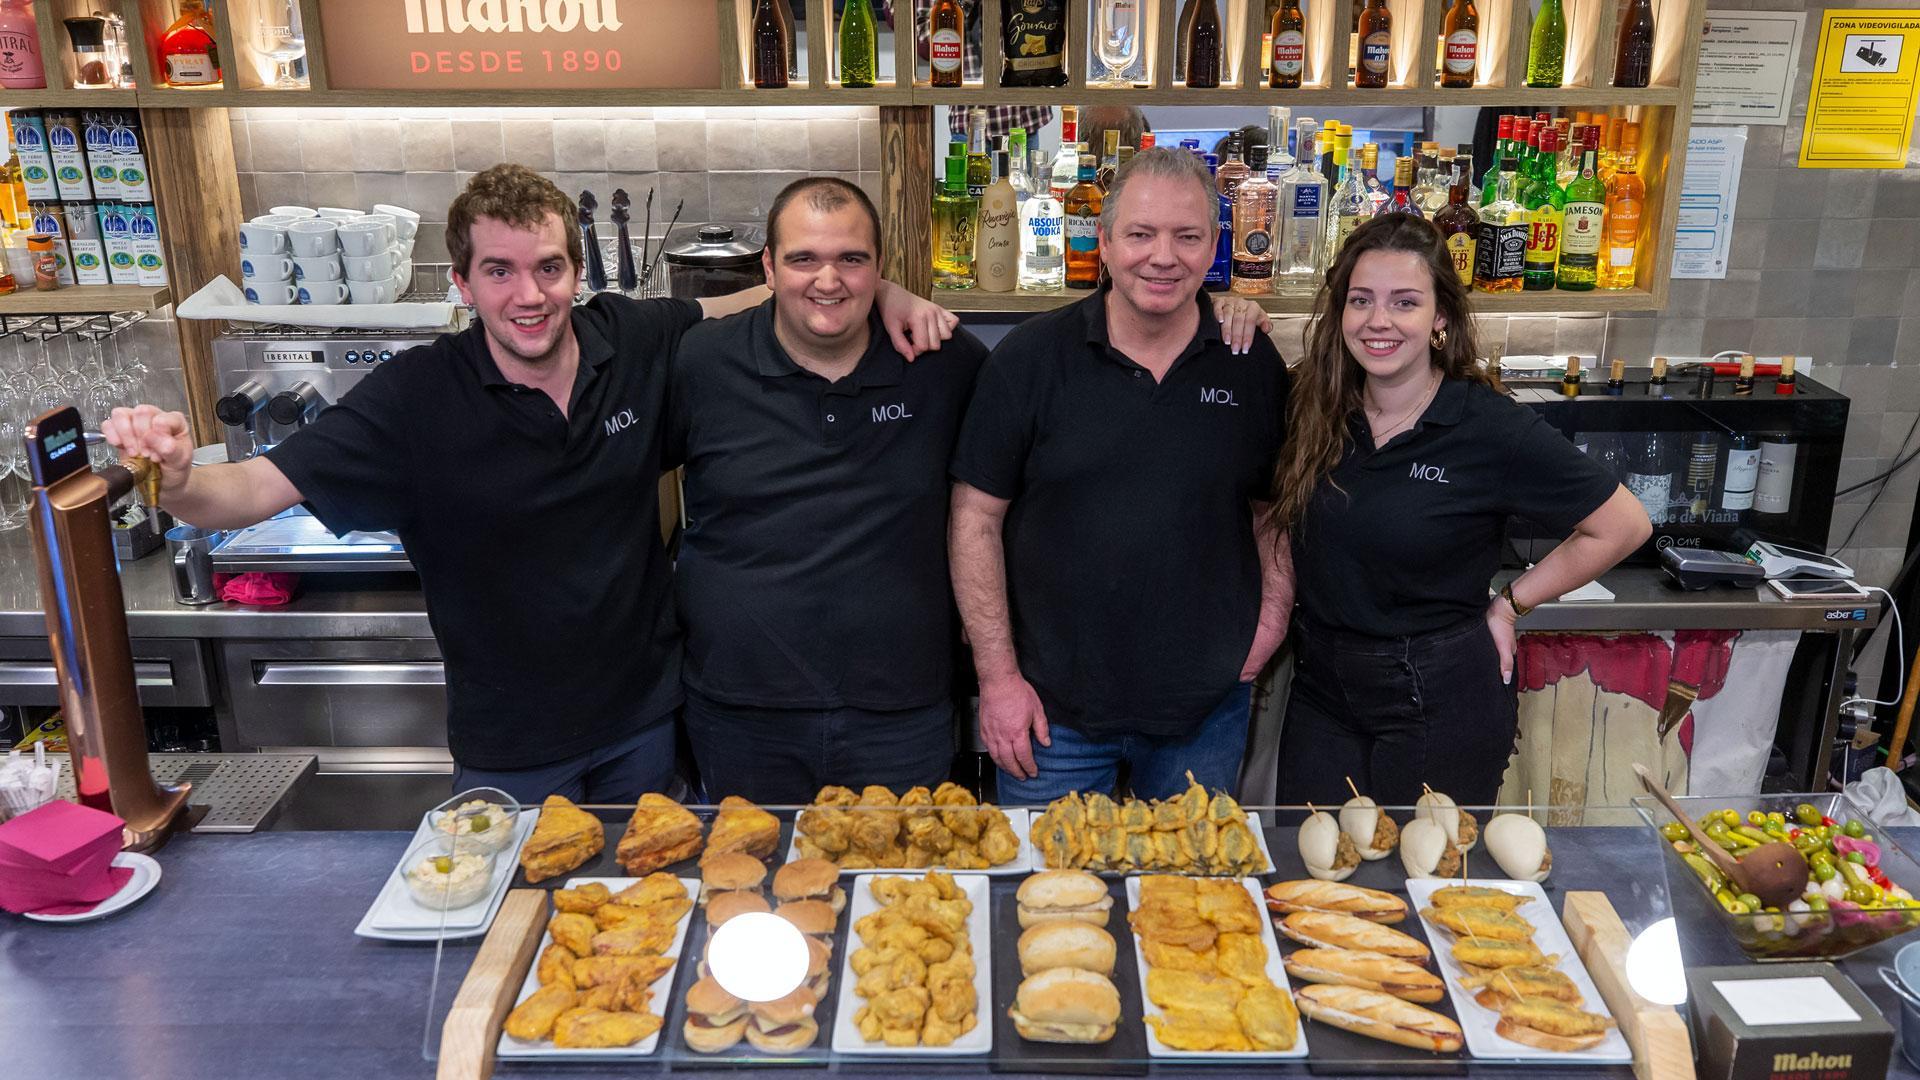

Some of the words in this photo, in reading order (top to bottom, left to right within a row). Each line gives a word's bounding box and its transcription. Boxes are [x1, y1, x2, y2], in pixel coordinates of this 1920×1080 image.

[1008, 12, 1059, 45] Gourmet
[1449, 45, 1475, 53] Mahou
[410, 51, 523, 73] DESDE
[542, 50, 622, 72] 1890
[1028, 216, 1063, 227] ABSOLUT
[1564, 206, 1603, 217] JAMESON
[1032, 226, 1061, 237] VODKA
[1526, 222, 1557, 251] J&B
[266, 353, 310, 361] IBERITAL
[1200, 386, 1239, 406] MOL
[604, 407, 640, 437] MOL
[872, 402, 912, 423] MOL
[1409, 462, 1449, 483] MOL
[1680, 509, 1696, 524] de
[1702, 509, 1739, 523] Viana
[1826, 609, 1851, 620] asber
[1773, 1051, 1853, 1072] Mahou
